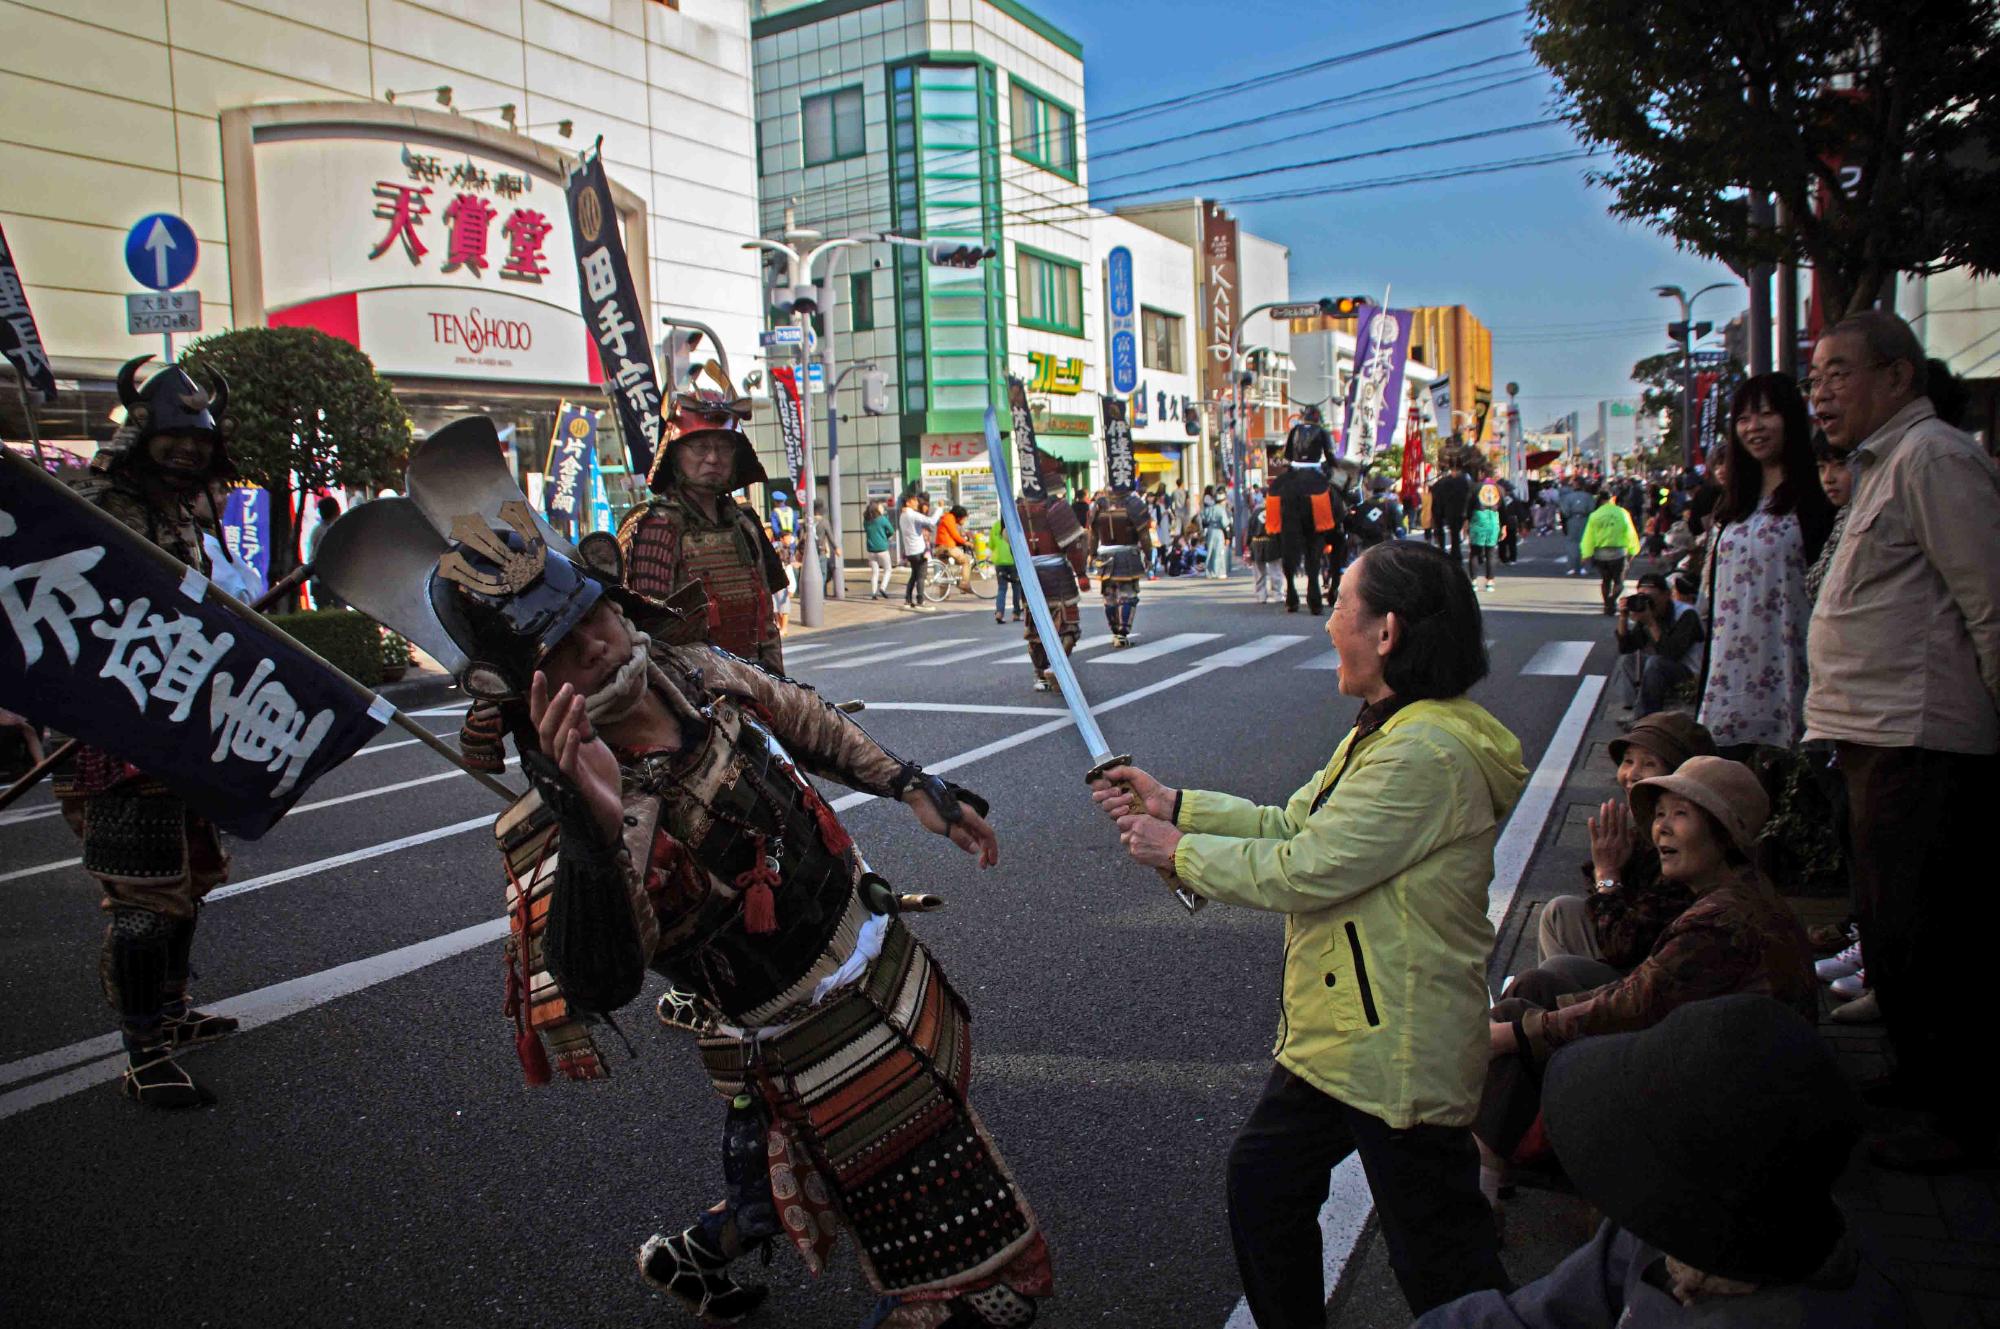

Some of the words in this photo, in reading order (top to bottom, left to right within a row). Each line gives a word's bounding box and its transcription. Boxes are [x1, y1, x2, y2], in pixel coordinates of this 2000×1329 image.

[369, 181, 554, 284] 天賞堂
[428, 307, 532, 354] TENSHODO
[1207, 264, 1232, 361] KANNO
[1028, 351, 1084, 396] フルーツ
[1116, 335, 1133, 384] 富久屋
[552, 437, 587, 514] 片倉景綱
[928, 441, 979, 457] たばこ
[1107, 419, 1133, 488] 伊達成実
[0, 510, 336, 799] 分盛重
